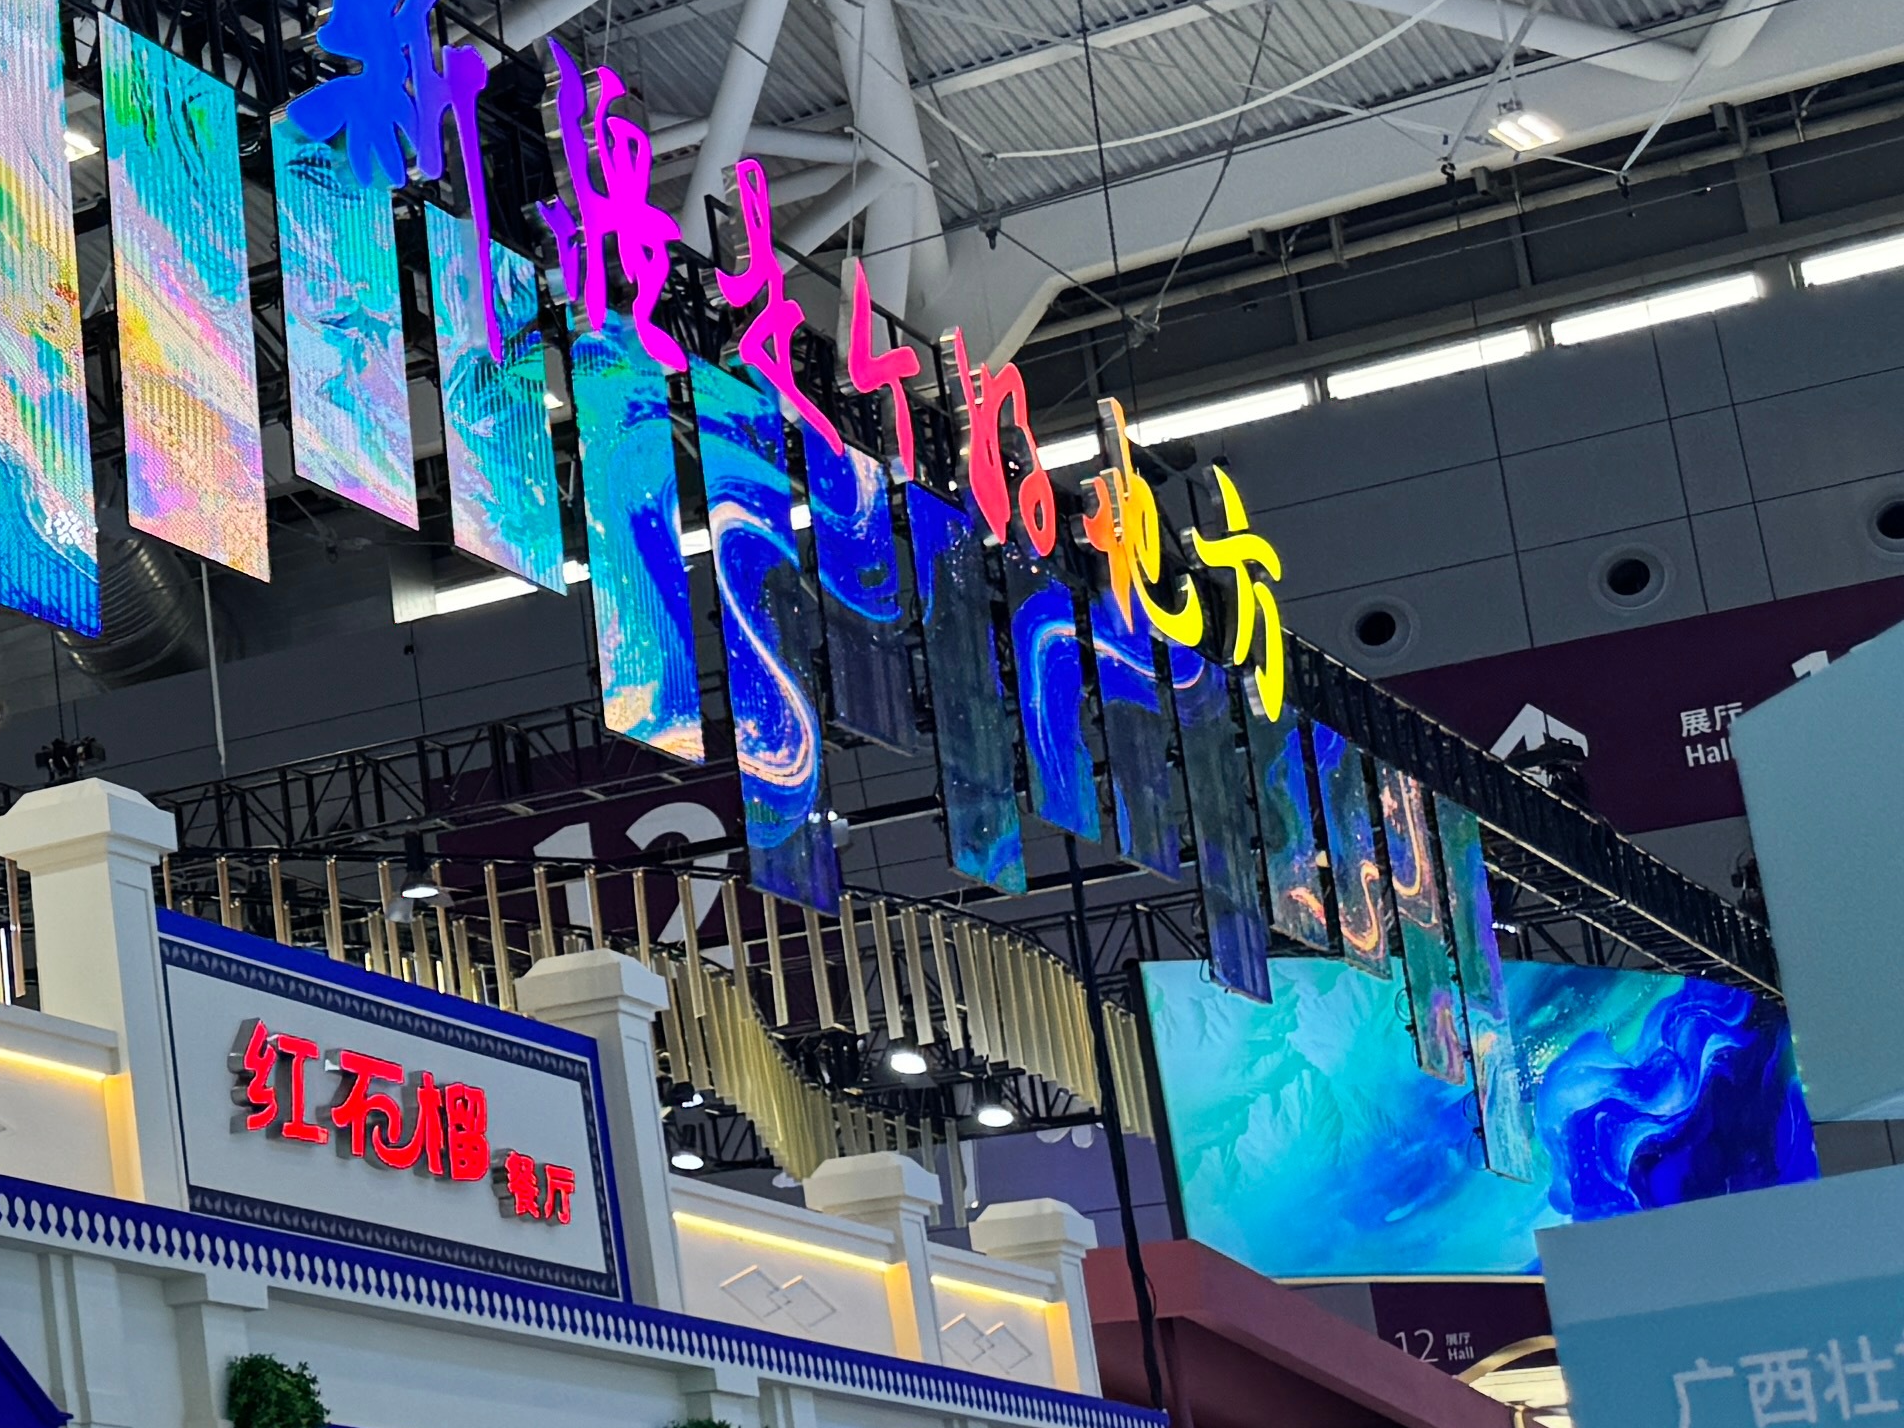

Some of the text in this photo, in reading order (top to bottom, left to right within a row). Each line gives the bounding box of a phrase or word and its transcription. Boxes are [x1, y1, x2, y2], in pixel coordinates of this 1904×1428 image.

[1680, 702, 1743, 738] 展厅
[1685, 737, 1732, 768] Hal
[242, 1019, 577, 1225] 红石榴 餐厅
[1395, 1329, 1439, 1363] 12
[1448, 1346, 1475, 1361] Hall
